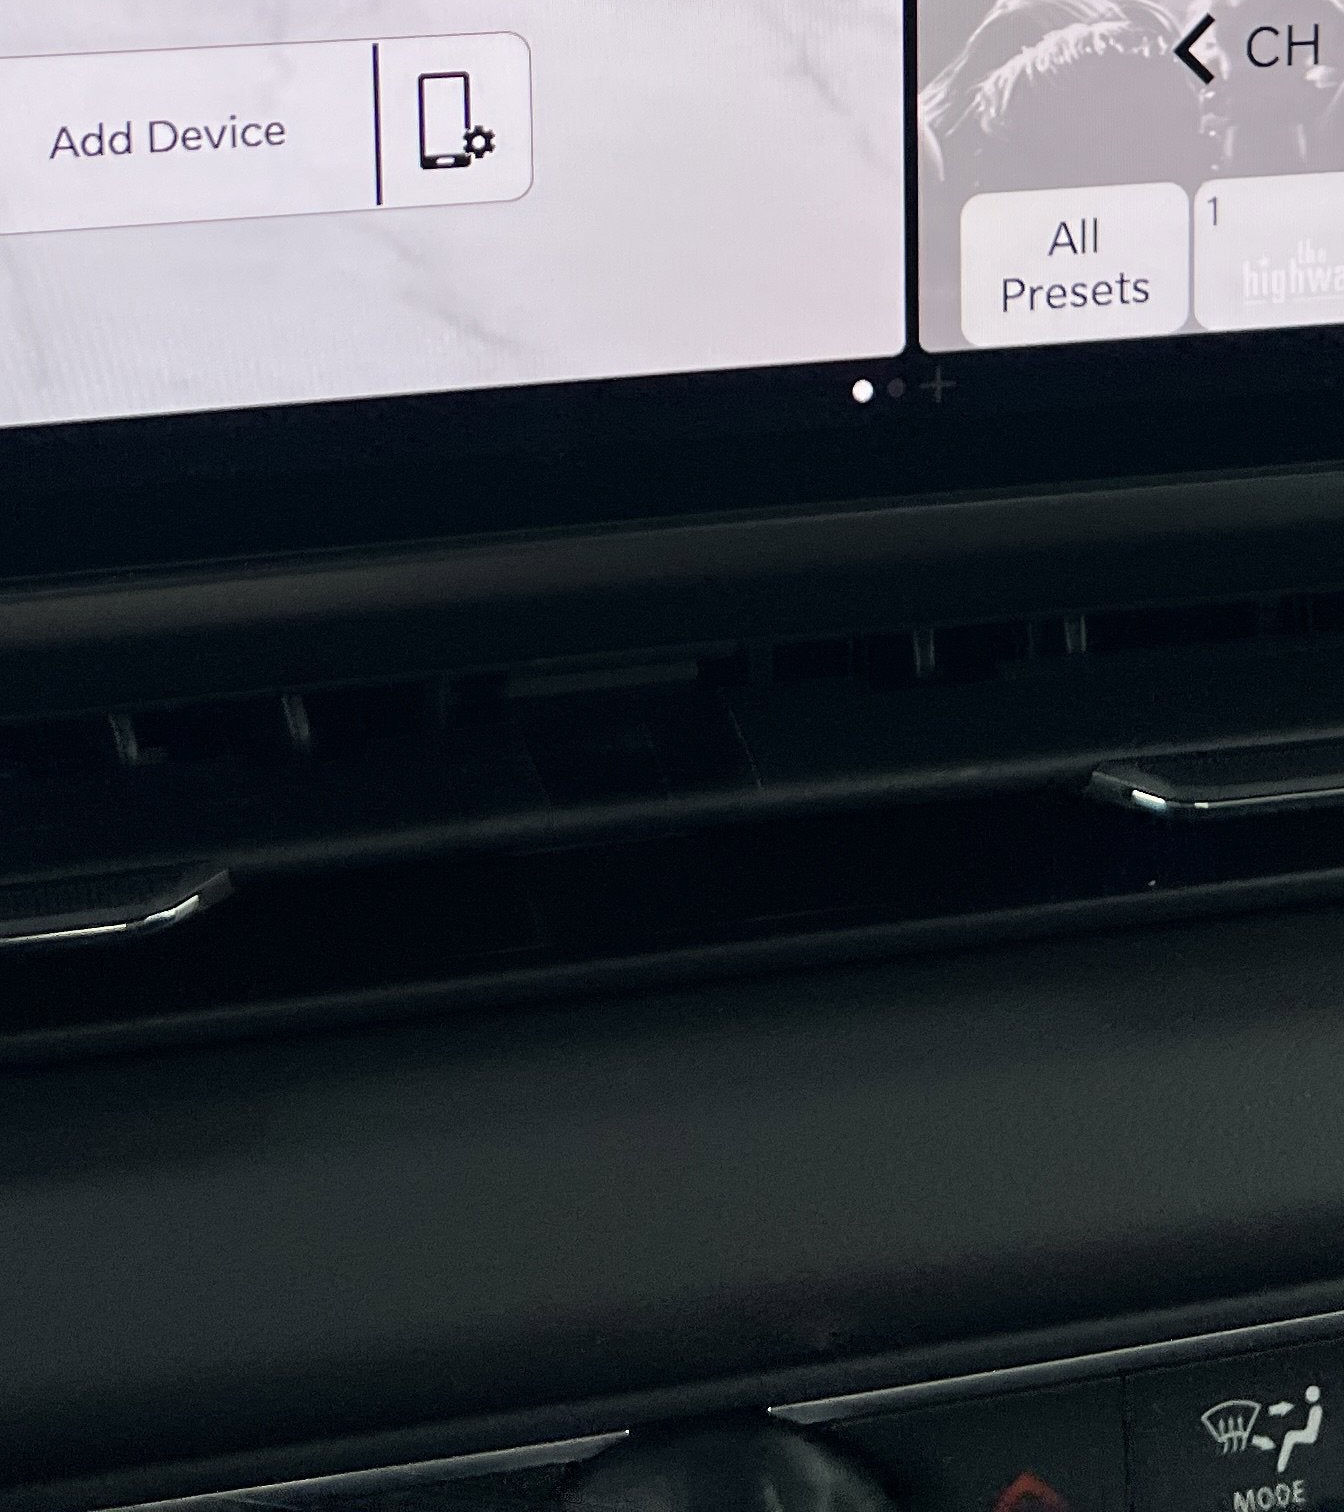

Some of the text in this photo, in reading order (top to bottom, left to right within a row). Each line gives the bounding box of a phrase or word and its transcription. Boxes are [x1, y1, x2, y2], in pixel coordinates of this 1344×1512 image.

[1246, 23, 1320, 68] CH
[49, 114, 286, 160] Add Device
[1207, 196, 1219, 226] 1
[1047, 217, 1099, 256] All
[1001, 272, 1150, 313] Presets
[1233, 1479, 1306, 1512] MODE
